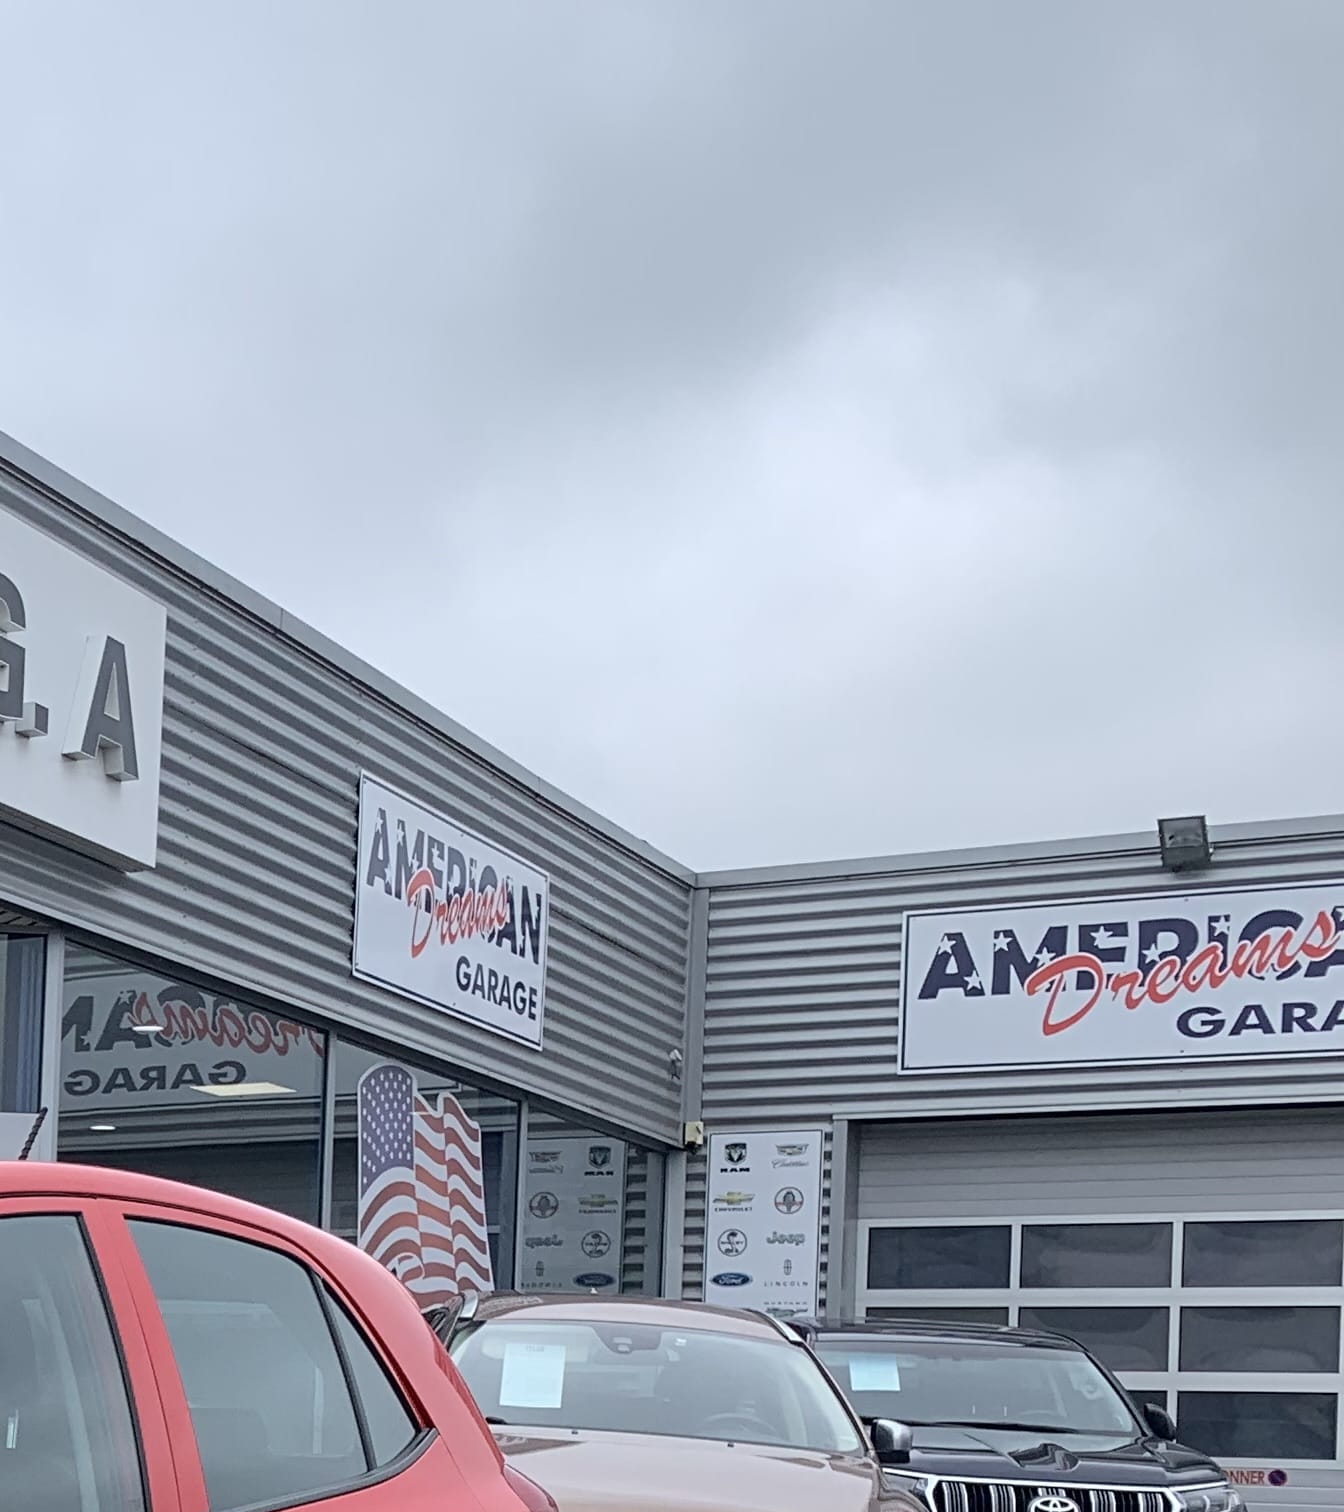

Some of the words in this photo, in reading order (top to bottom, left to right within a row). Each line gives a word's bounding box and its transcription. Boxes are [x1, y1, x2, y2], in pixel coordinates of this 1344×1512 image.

[407, 867, 511, 959] Dreams
[455, 955, 538, 1021] GARAGE
[1026, 909, 1340, 1036] Dreams
[766, 1230, 806, 1246] Jeep
